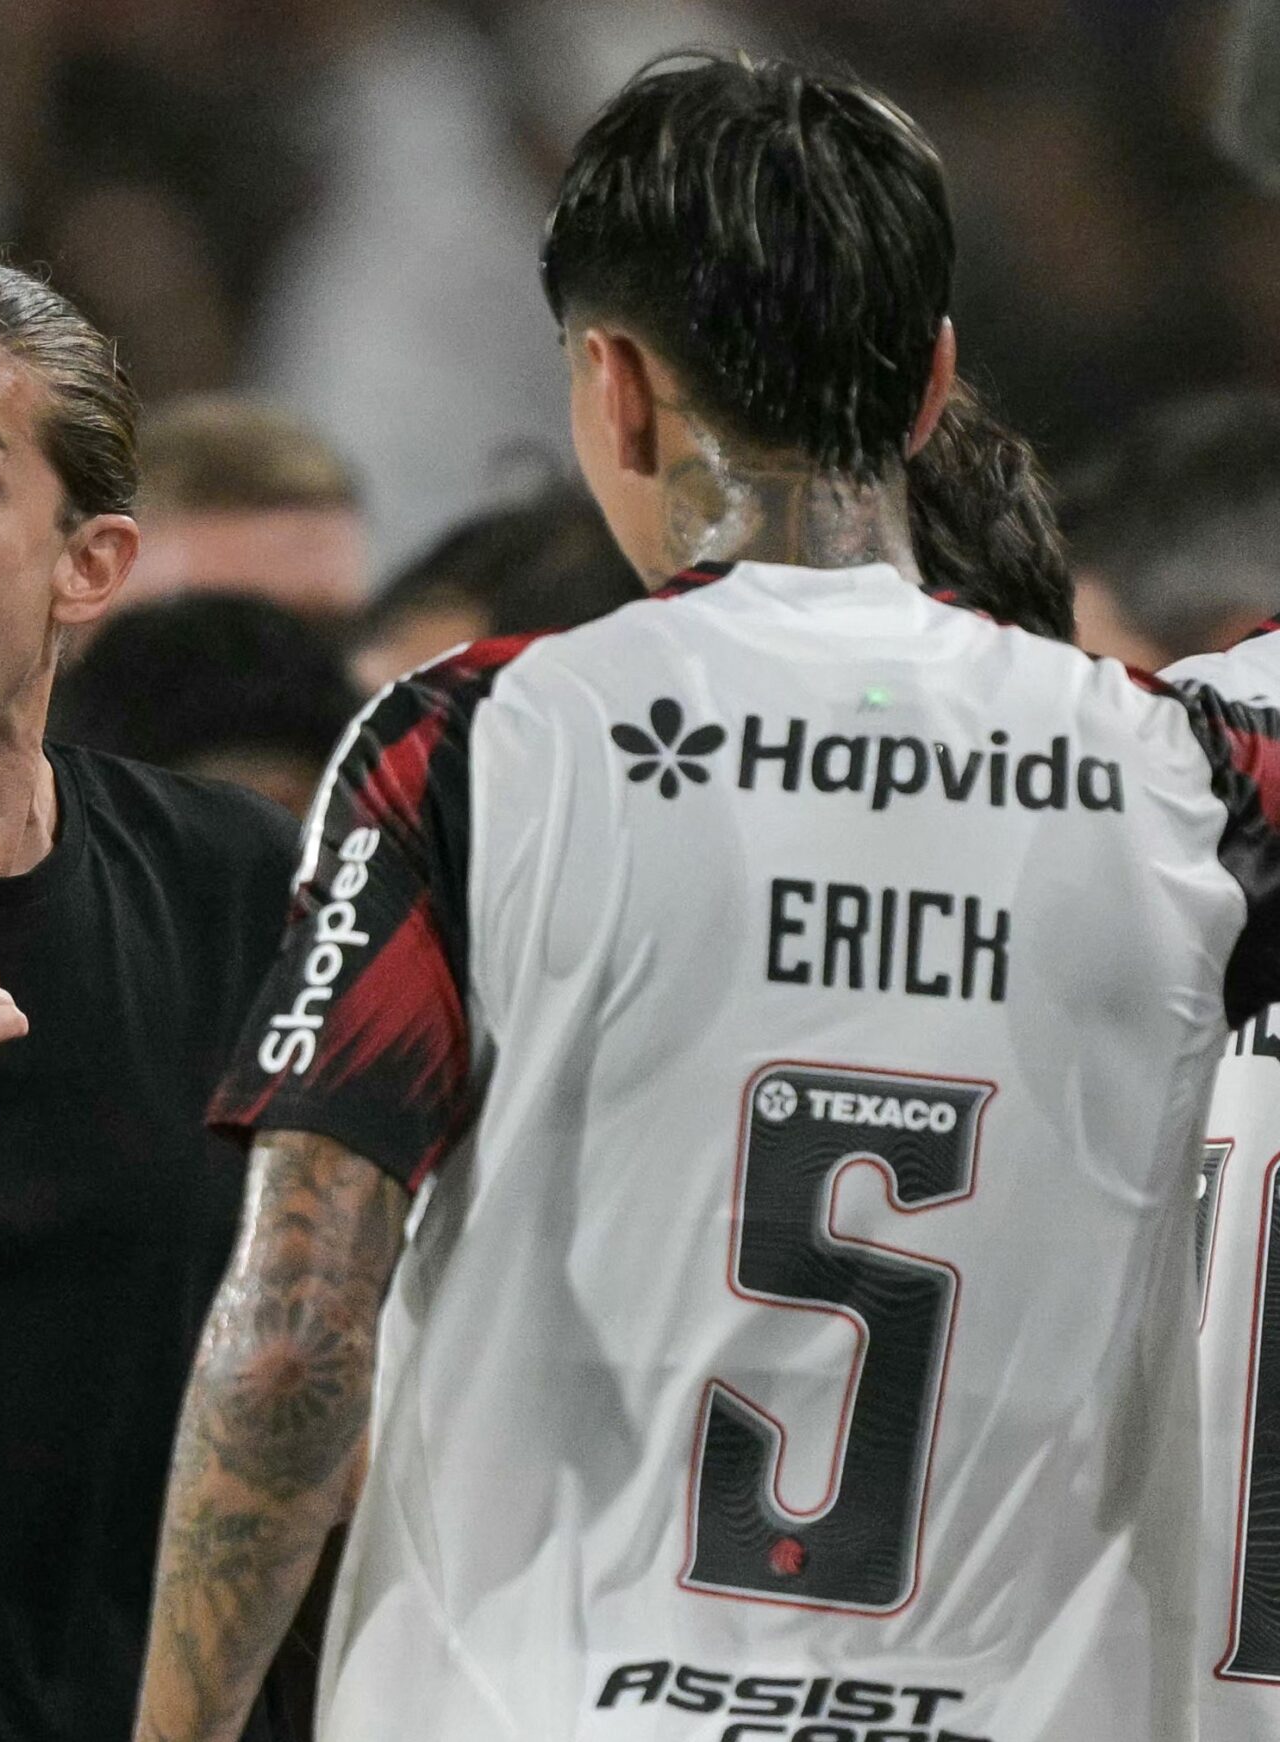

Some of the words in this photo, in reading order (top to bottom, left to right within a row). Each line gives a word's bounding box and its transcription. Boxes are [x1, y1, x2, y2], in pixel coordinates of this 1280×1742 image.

[736, 714, 1126, 814] Hapvida
[258, 826, 381, 1076] Shopee
[767, 877, 1011, 1003] ERICK
[809, 1090, 957, 1133] TEXACO
[677, 1058, 998, 1618] 5
[595, 1660, 966, 1725] ASSIST
